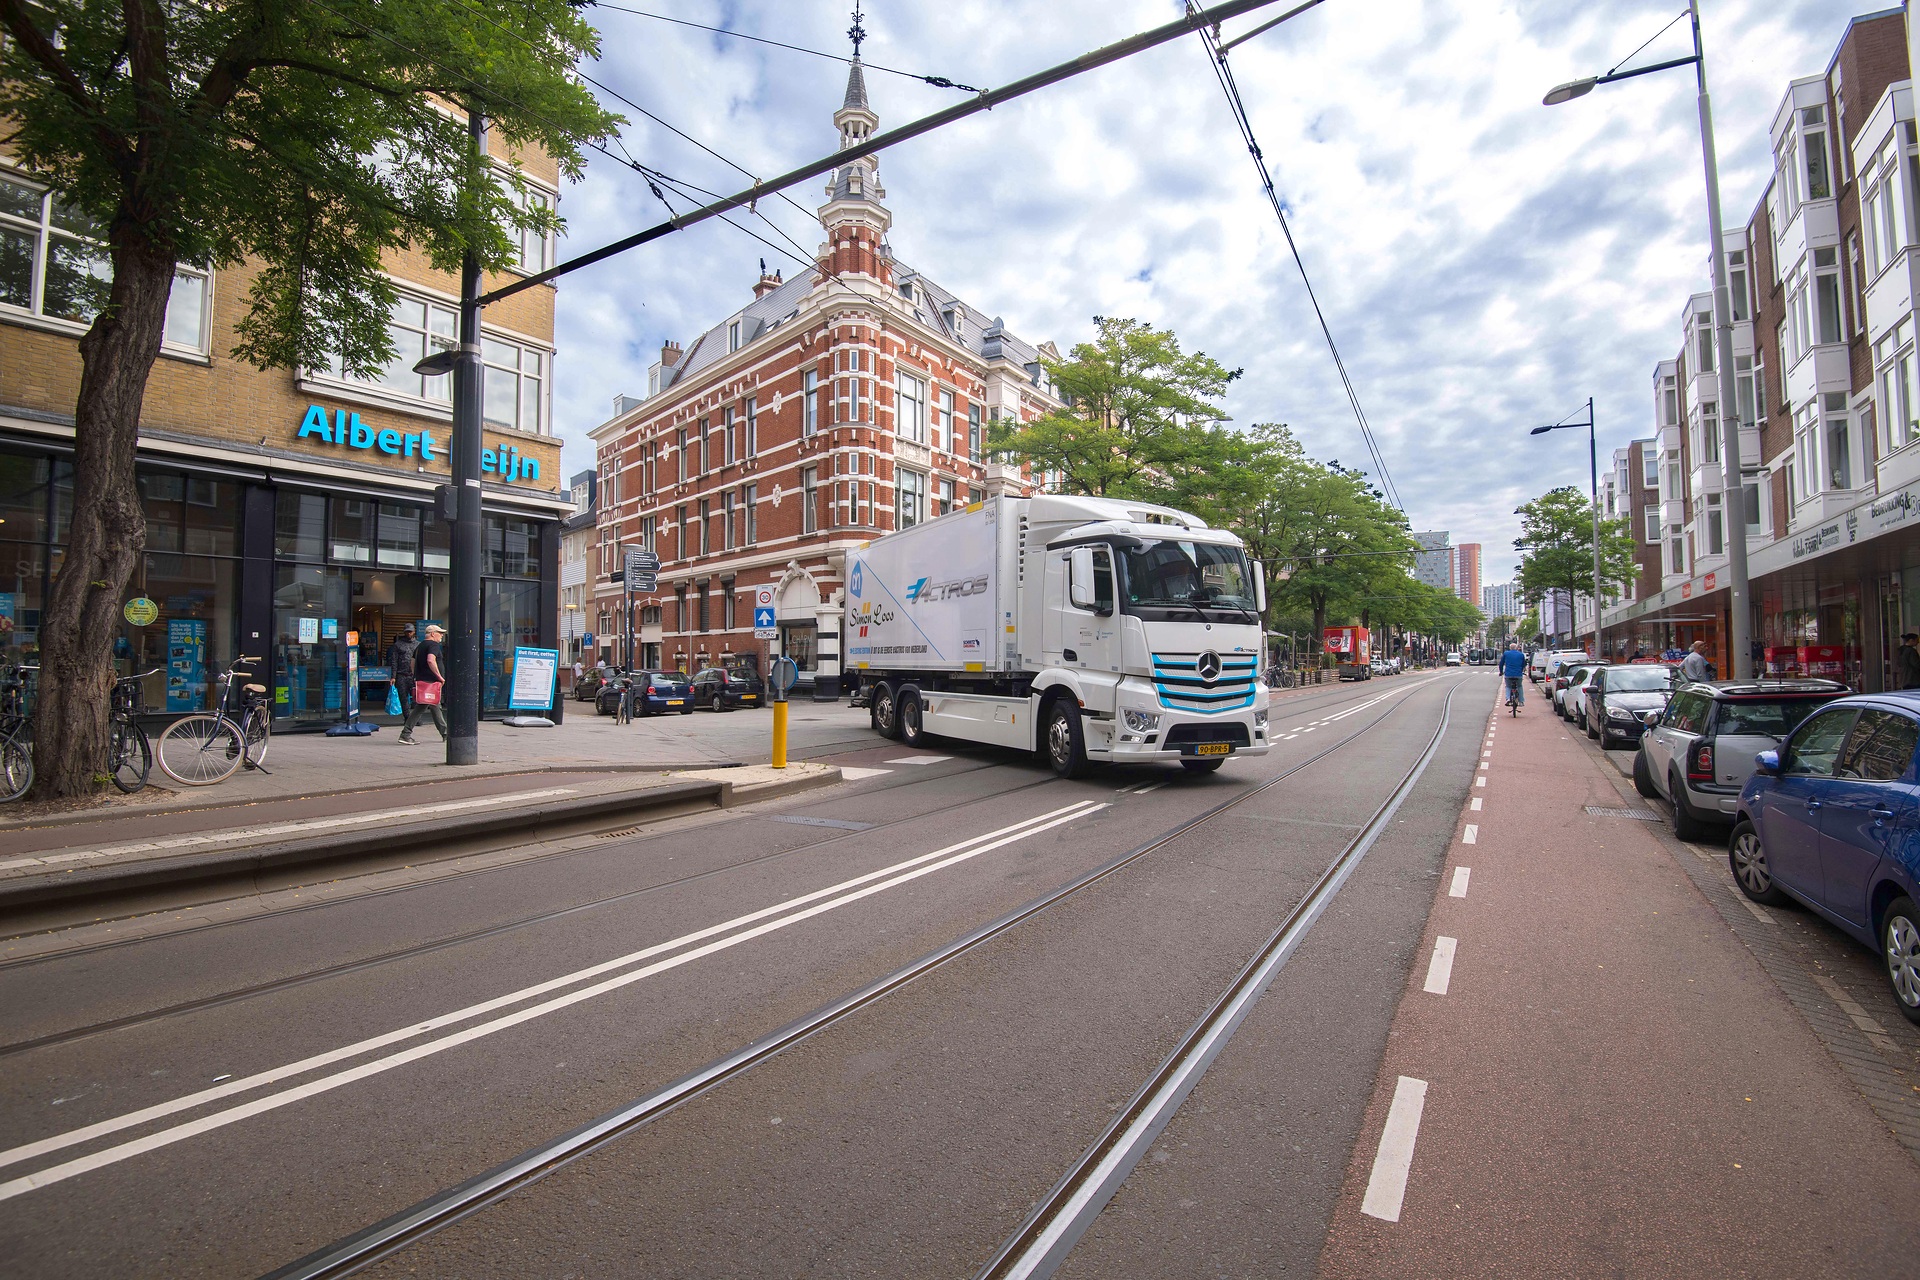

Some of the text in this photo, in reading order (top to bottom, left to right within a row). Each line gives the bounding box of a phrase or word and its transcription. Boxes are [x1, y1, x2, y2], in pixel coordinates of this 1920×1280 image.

[298, 404, 540, 482] Albert eijn
[850, 604, 894, 627] Simon Loos
[1200, 745, 1228, 754] 90-BPR-5
